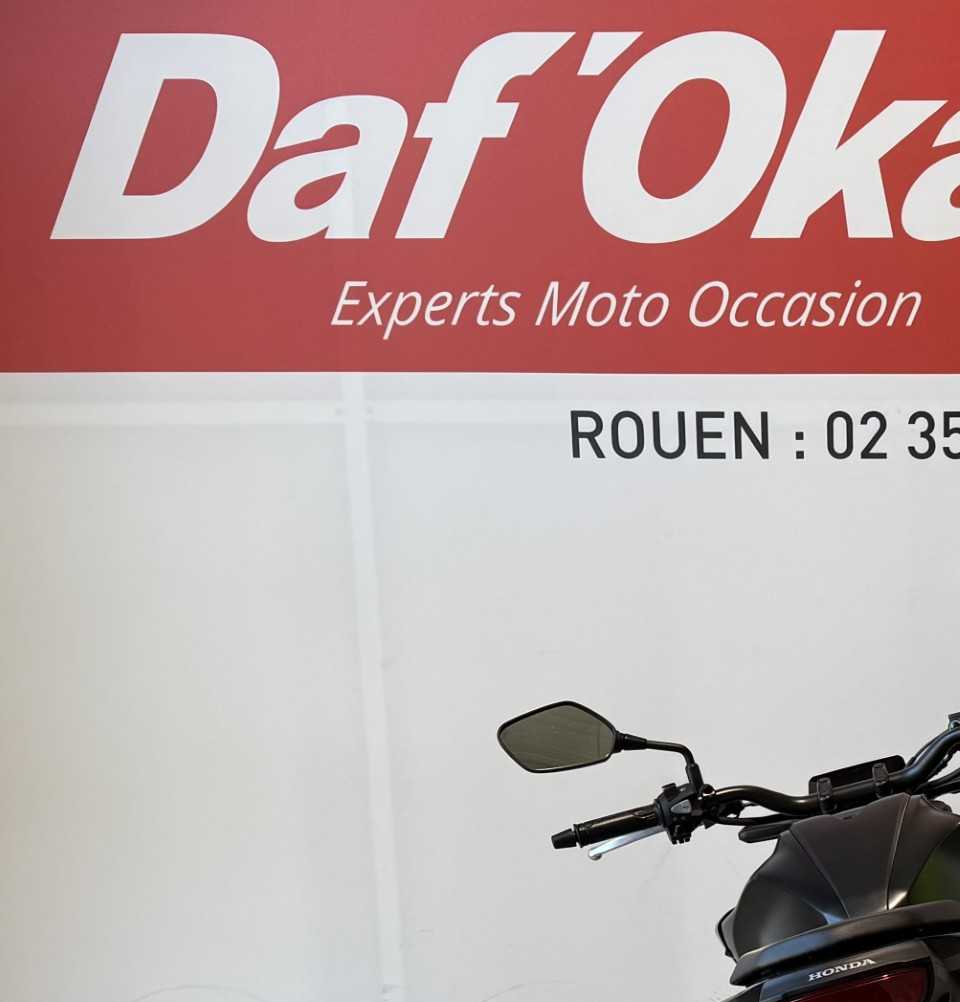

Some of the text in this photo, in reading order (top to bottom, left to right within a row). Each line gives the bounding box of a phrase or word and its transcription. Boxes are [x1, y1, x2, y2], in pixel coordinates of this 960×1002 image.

[331, 280, 922, 340] Experts Moto Occasion
[571, 411, 769, 460] ROUEN
[795, 431, 805, 460] :
[826, 411, 888, 460] 02
[808, 958, 877, 982] HONDA
